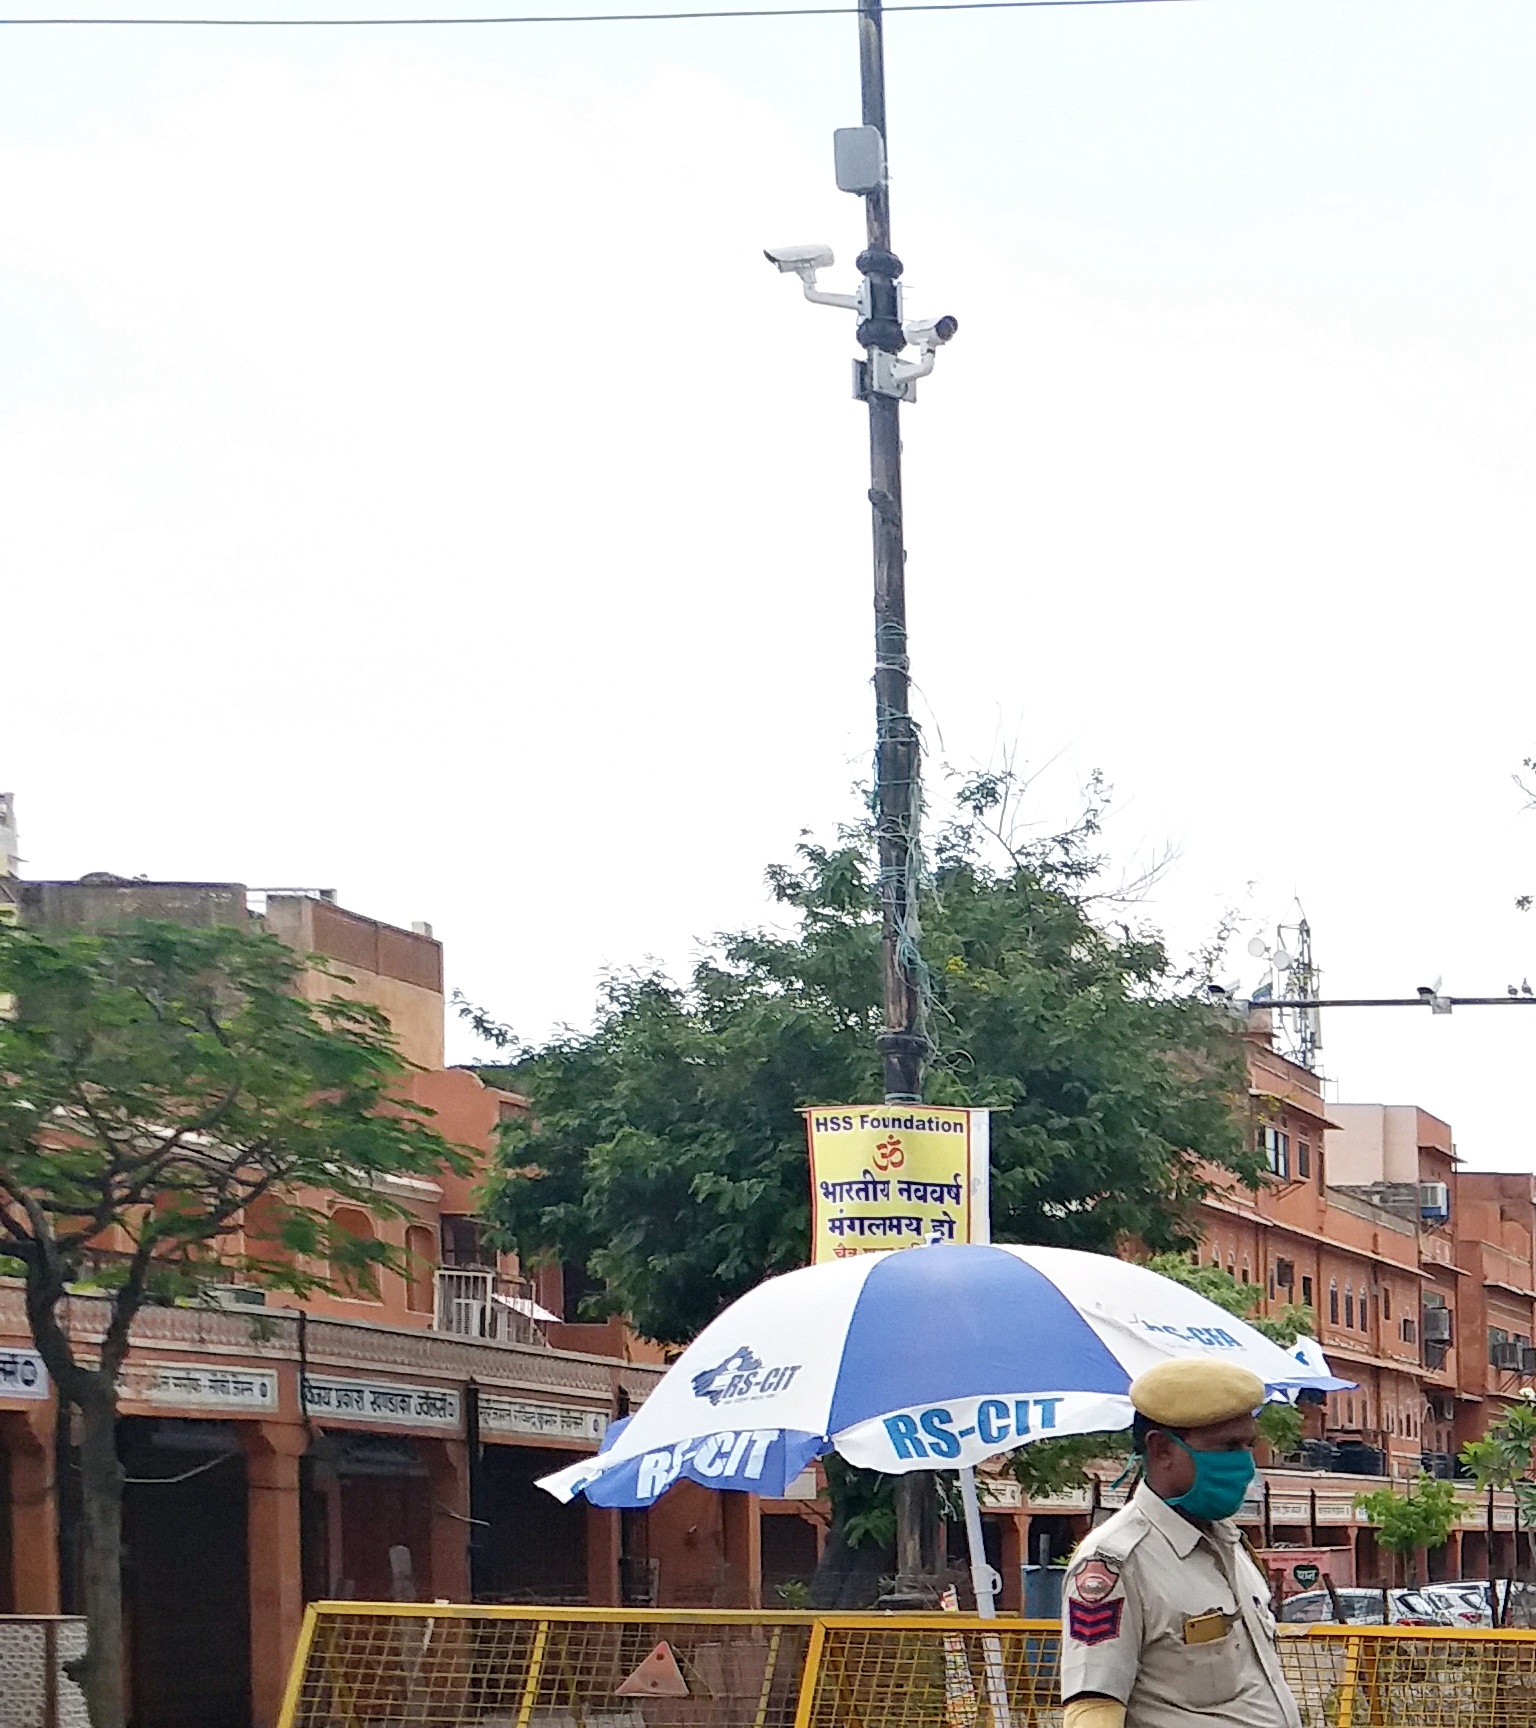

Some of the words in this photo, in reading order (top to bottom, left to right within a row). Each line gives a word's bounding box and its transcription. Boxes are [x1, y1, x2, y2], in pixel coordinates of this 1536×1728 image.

[815, 1116, 853, 1132] HSS
[860, 1115, 964, 1133] Foundation
[820, 1169, 890, 1203] भारतीय
[897, 1173, 962, 1205] नववर्ष
[828, 1208, 923, 1236] मंगलमय
[930, 1211, 956, 1239] हो
[722, 1364, 802, 1398] RS-CIT
[883, 1397, 1064, 1460] RS-CIT
